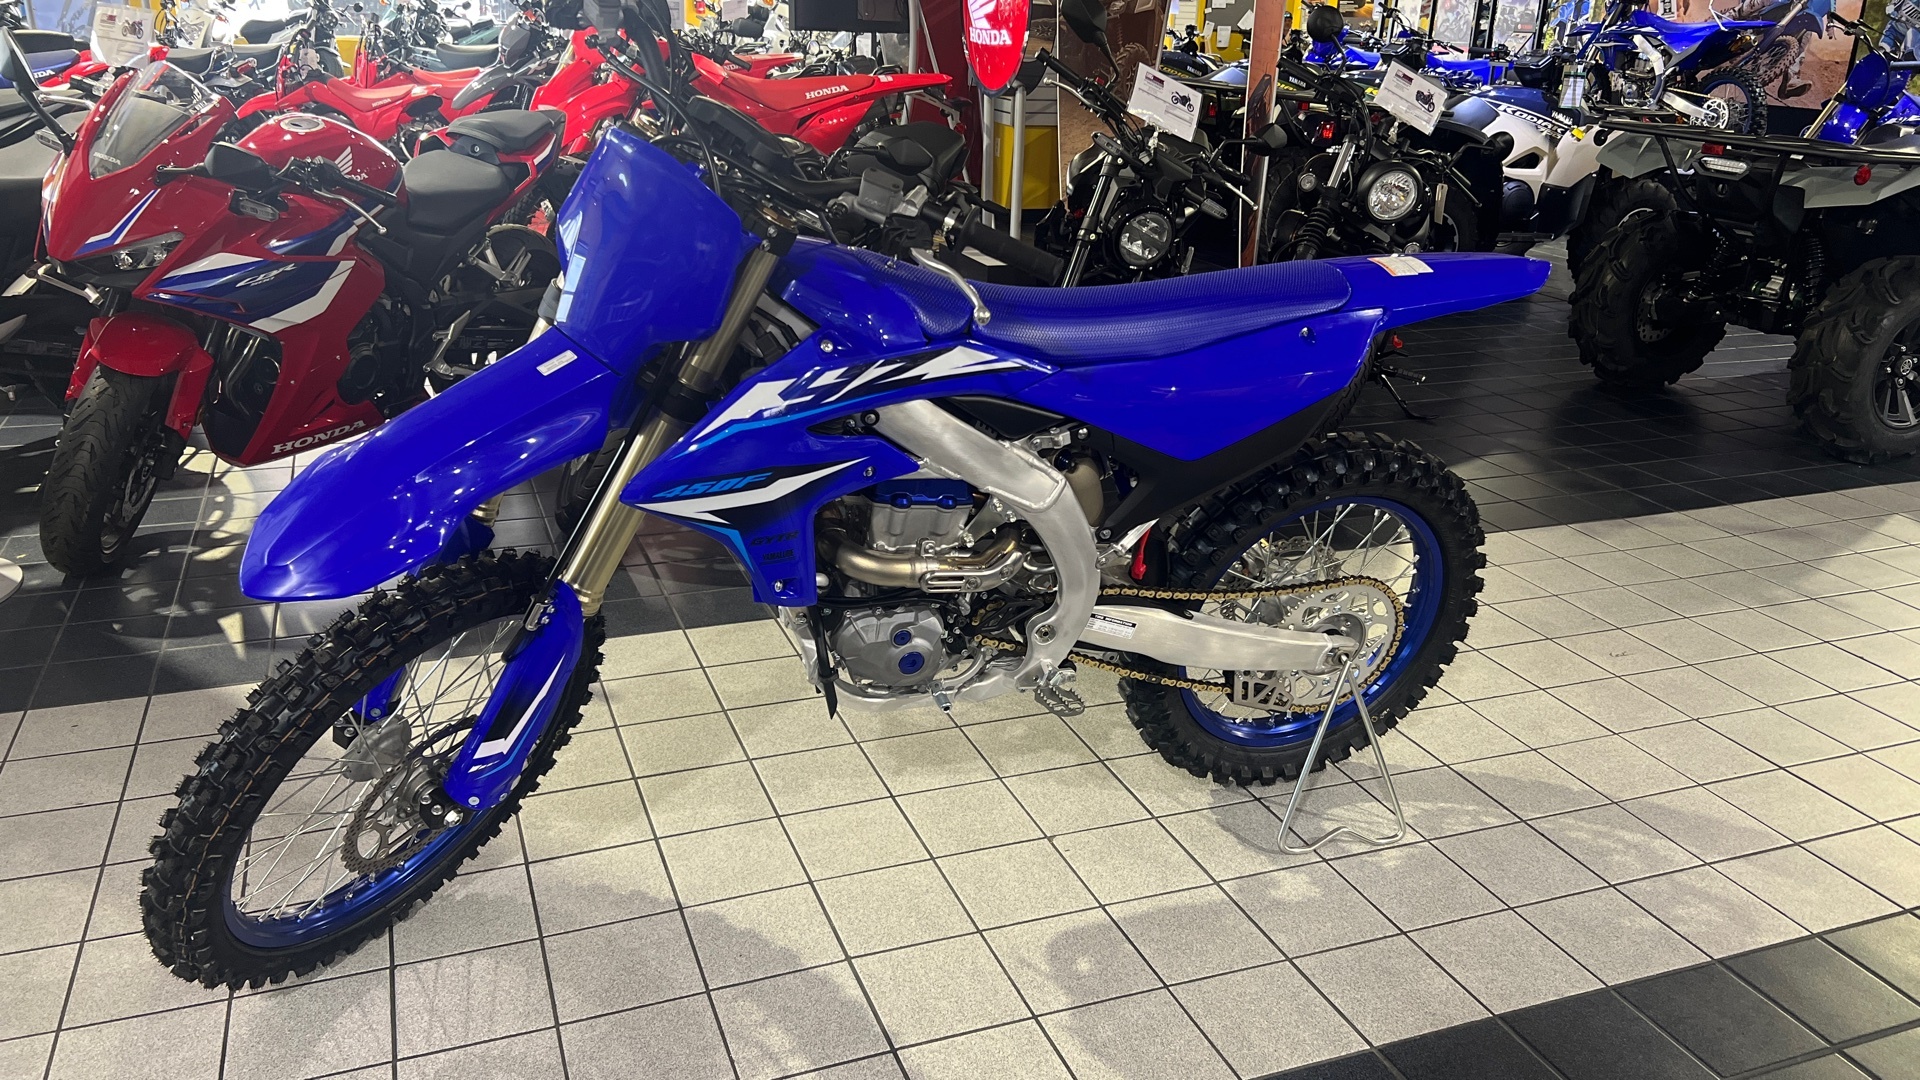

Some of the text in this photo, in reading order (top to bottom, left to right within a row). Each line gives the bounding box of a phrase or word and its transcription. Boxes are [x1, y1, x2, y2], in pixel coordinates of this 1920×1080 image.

[969, 26, 1012, 46] HONDA
[1186, 65, 1202, 77] YAMAHA
[1288, 75, 1307, 88] YAMAHA
[805, 84, 849, 100] HONDA
[1497, 104, 1565, 134] KODIAK
[1551, 110, 1573, 125] YAMAHA
[92, 151, 121, 165] HONDA
[271, 420, 366, 454] HONDA
[651, 471, 774, 499] 450F
[751, 529, 799, 546] GYTR
